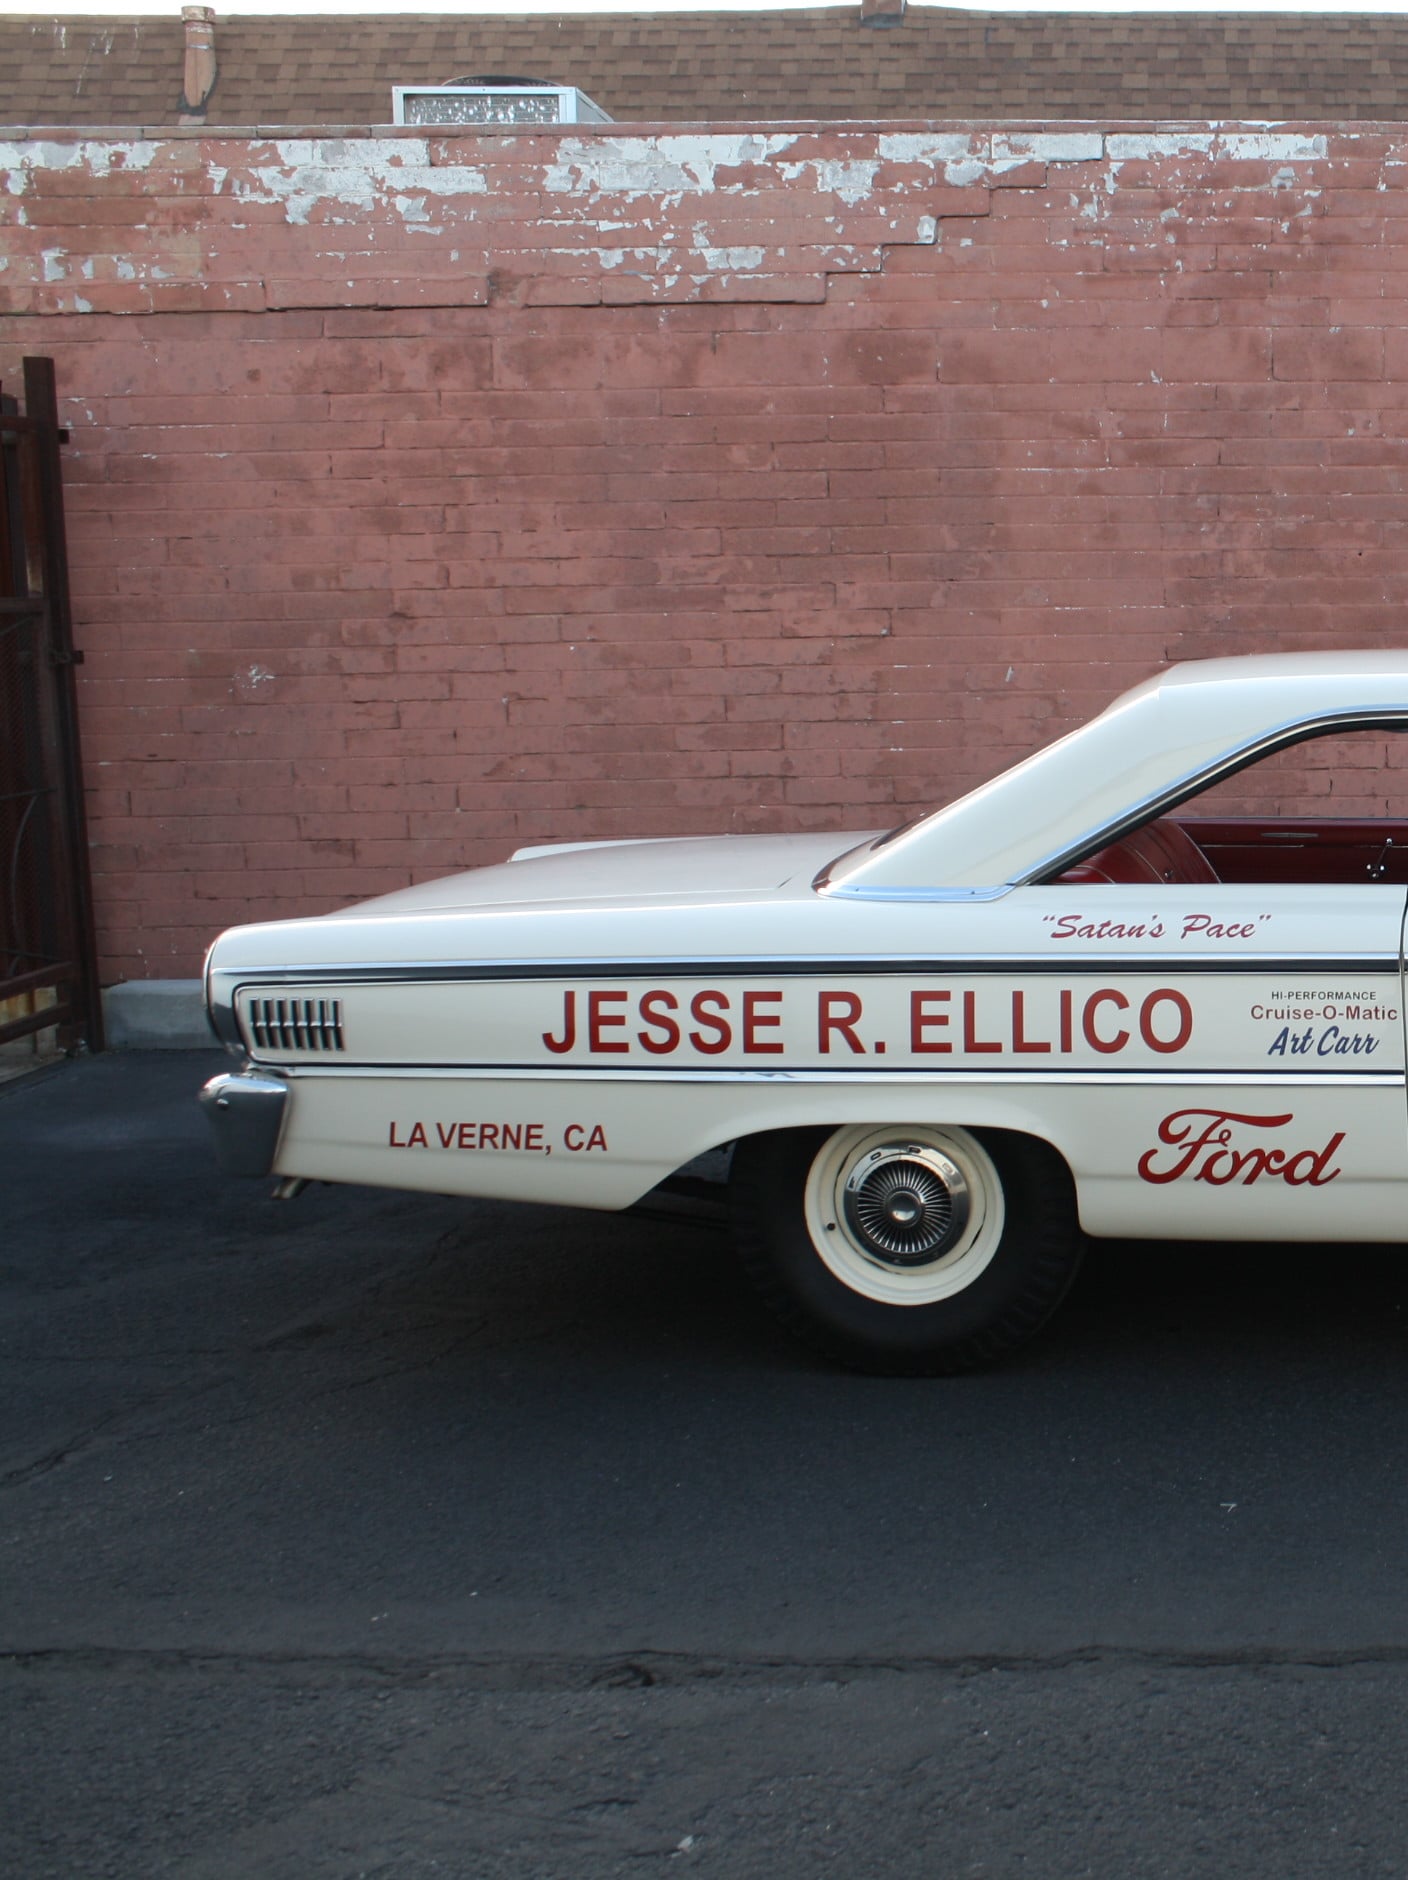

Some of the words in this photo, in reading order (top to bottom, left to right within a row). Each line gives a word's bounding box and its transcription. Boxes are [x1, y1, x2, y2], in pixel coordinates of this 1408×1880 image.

[1271, 991, 1377, 1001] HI-PERFORMANCE
[542, 989, 785, 1055] JESSE
[818, 990, 888, 1055] R.
[910, 988, 1194, 1055] ELLICO
[1250, 1004, 1398, 1021] Cruise-O-Matic
[1267, 1026, 1315, 1056] Art
[1316, 1025, 1380, 1057] Carr
[389, 1121, 430, 1148] LA
[435, 1122, 553, 1154] VERNE,
[564, 1123, 608, 1152] CA
[1137, 1108, 1347, 1187] Ford
